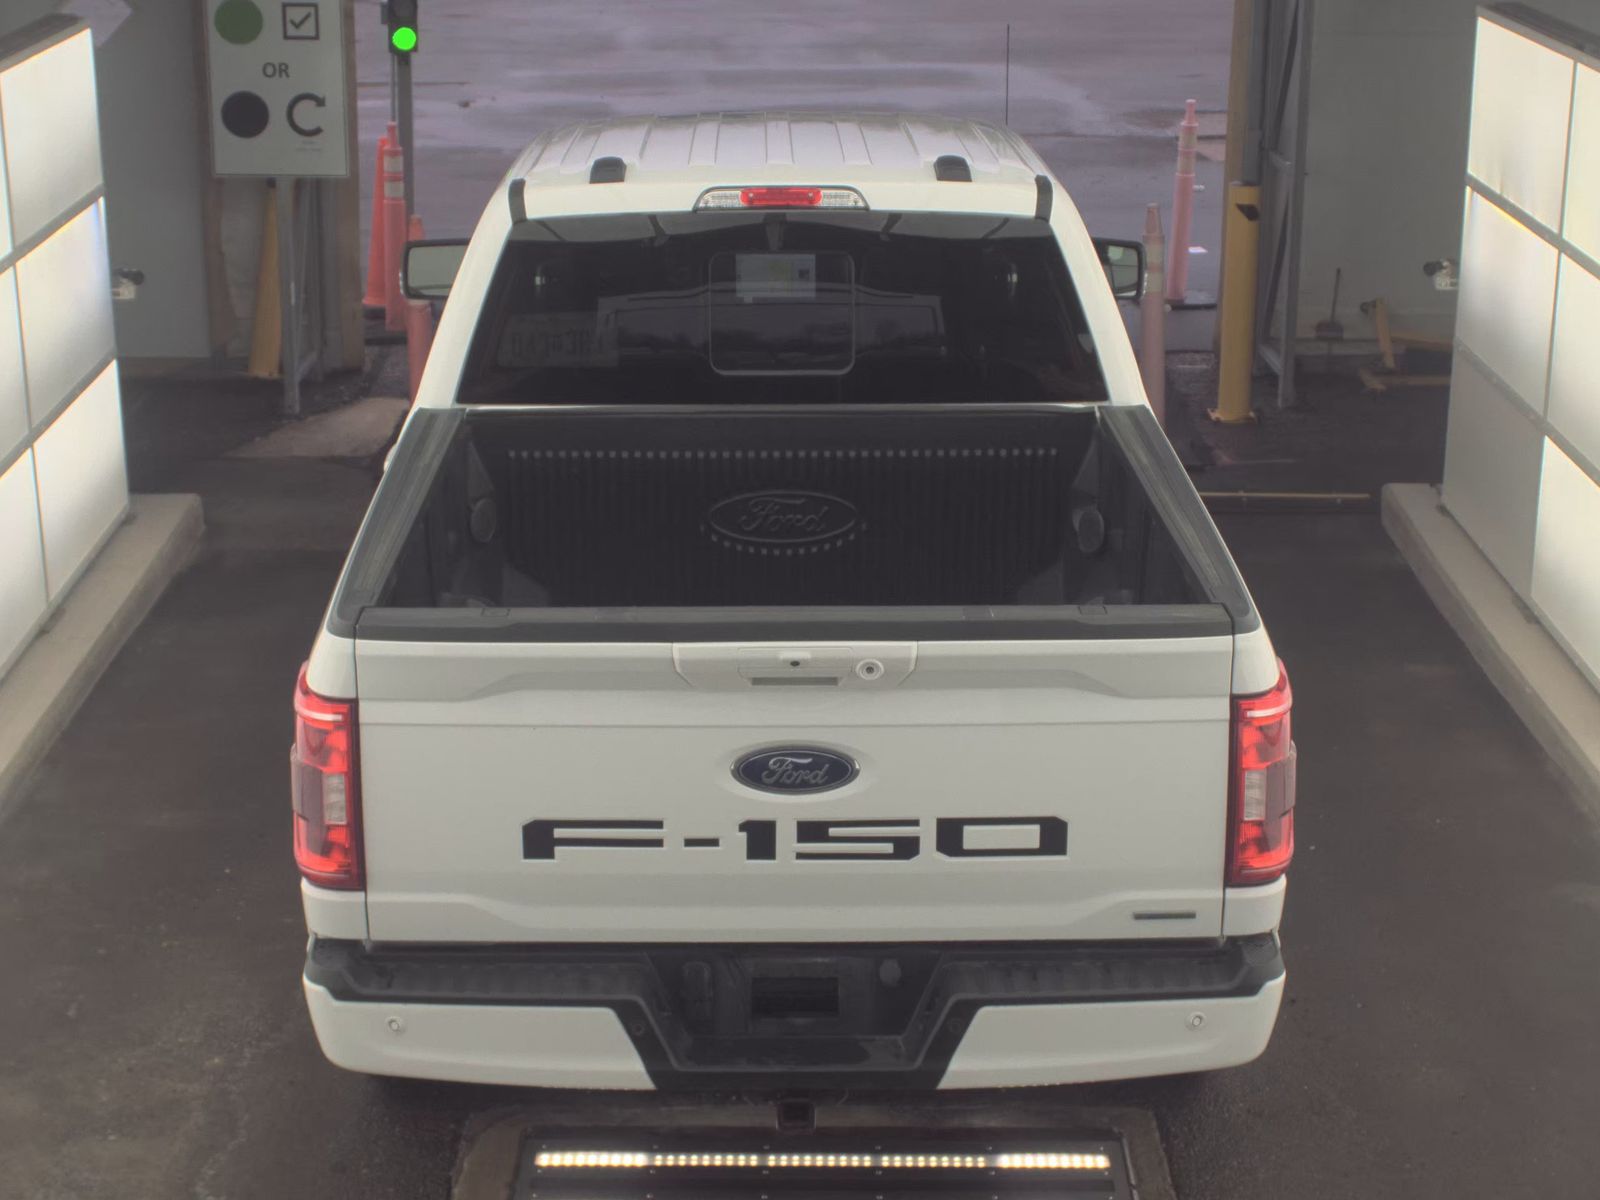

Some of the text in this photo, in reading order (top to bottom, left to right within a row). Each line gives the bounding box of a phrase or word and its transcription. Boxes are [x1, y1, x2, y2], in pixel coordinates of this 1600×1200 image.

[262, 62, 290, 78] OR
[738, 496, 830, 532] Ford
[761, 756, 830, 784] Ford
[521, 816, 1068, 861] F-150
